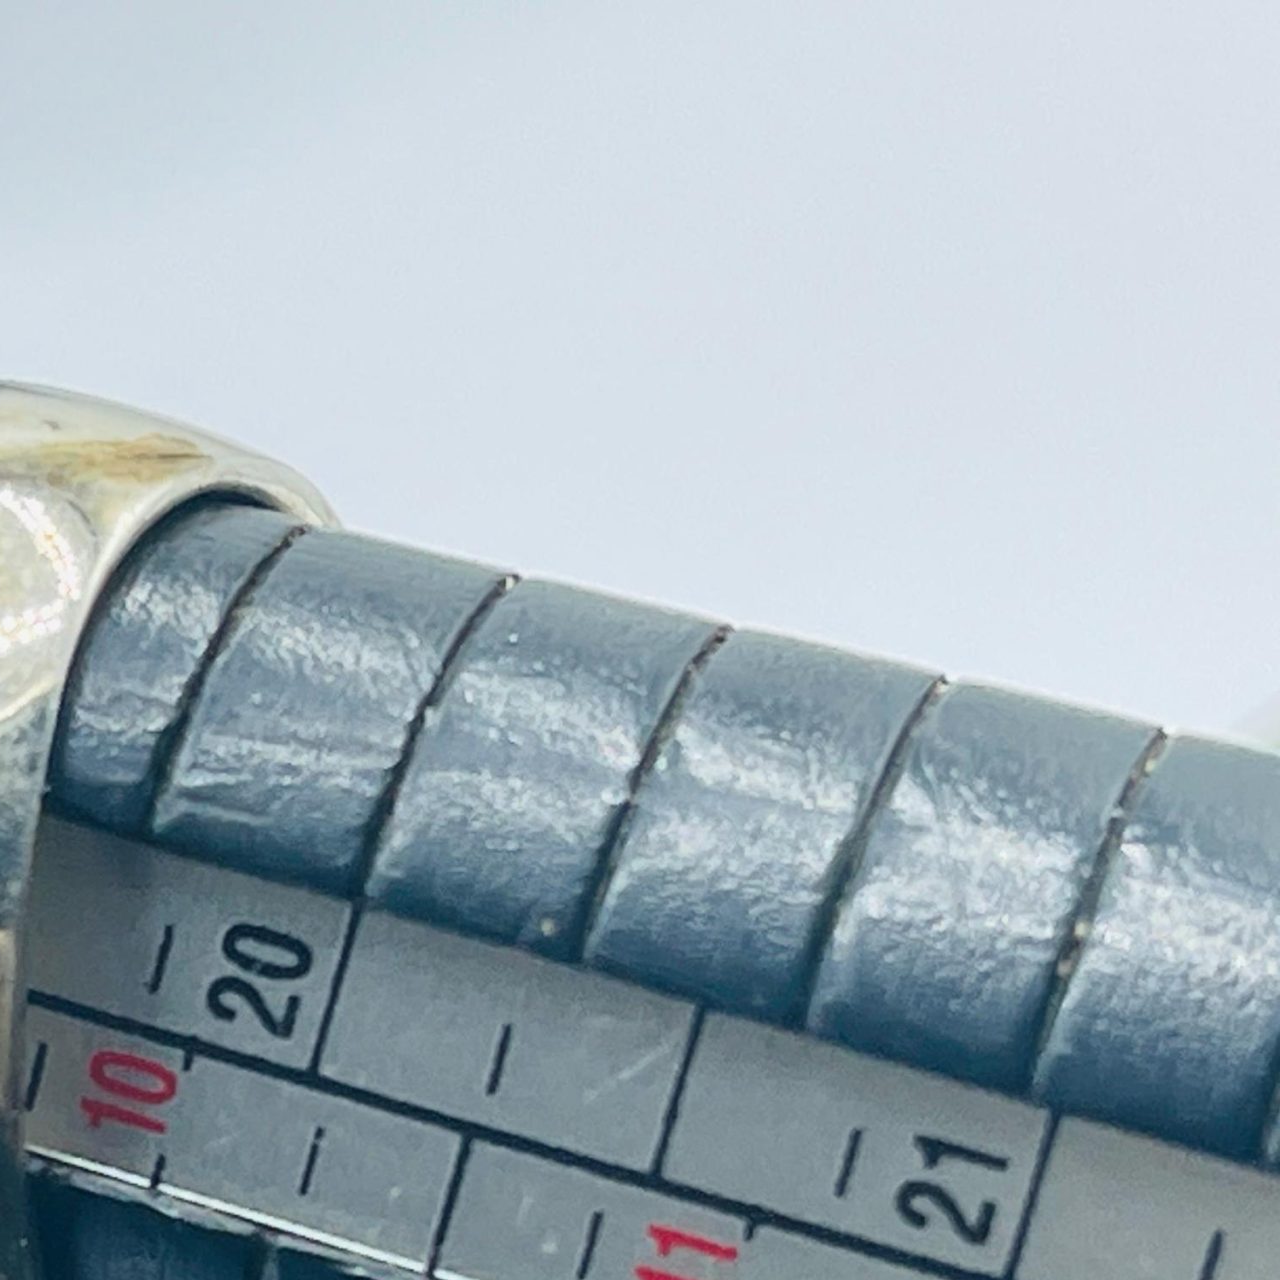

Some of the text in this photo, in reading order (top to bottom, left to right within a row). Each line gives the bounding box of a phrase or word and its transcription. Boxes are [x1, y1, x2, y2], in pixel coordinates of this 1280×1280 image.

[207, 922, 314, 1038] 20
[81, 1051, 177, 1133] 10
[896, 1135, 1010, 1246] 21
